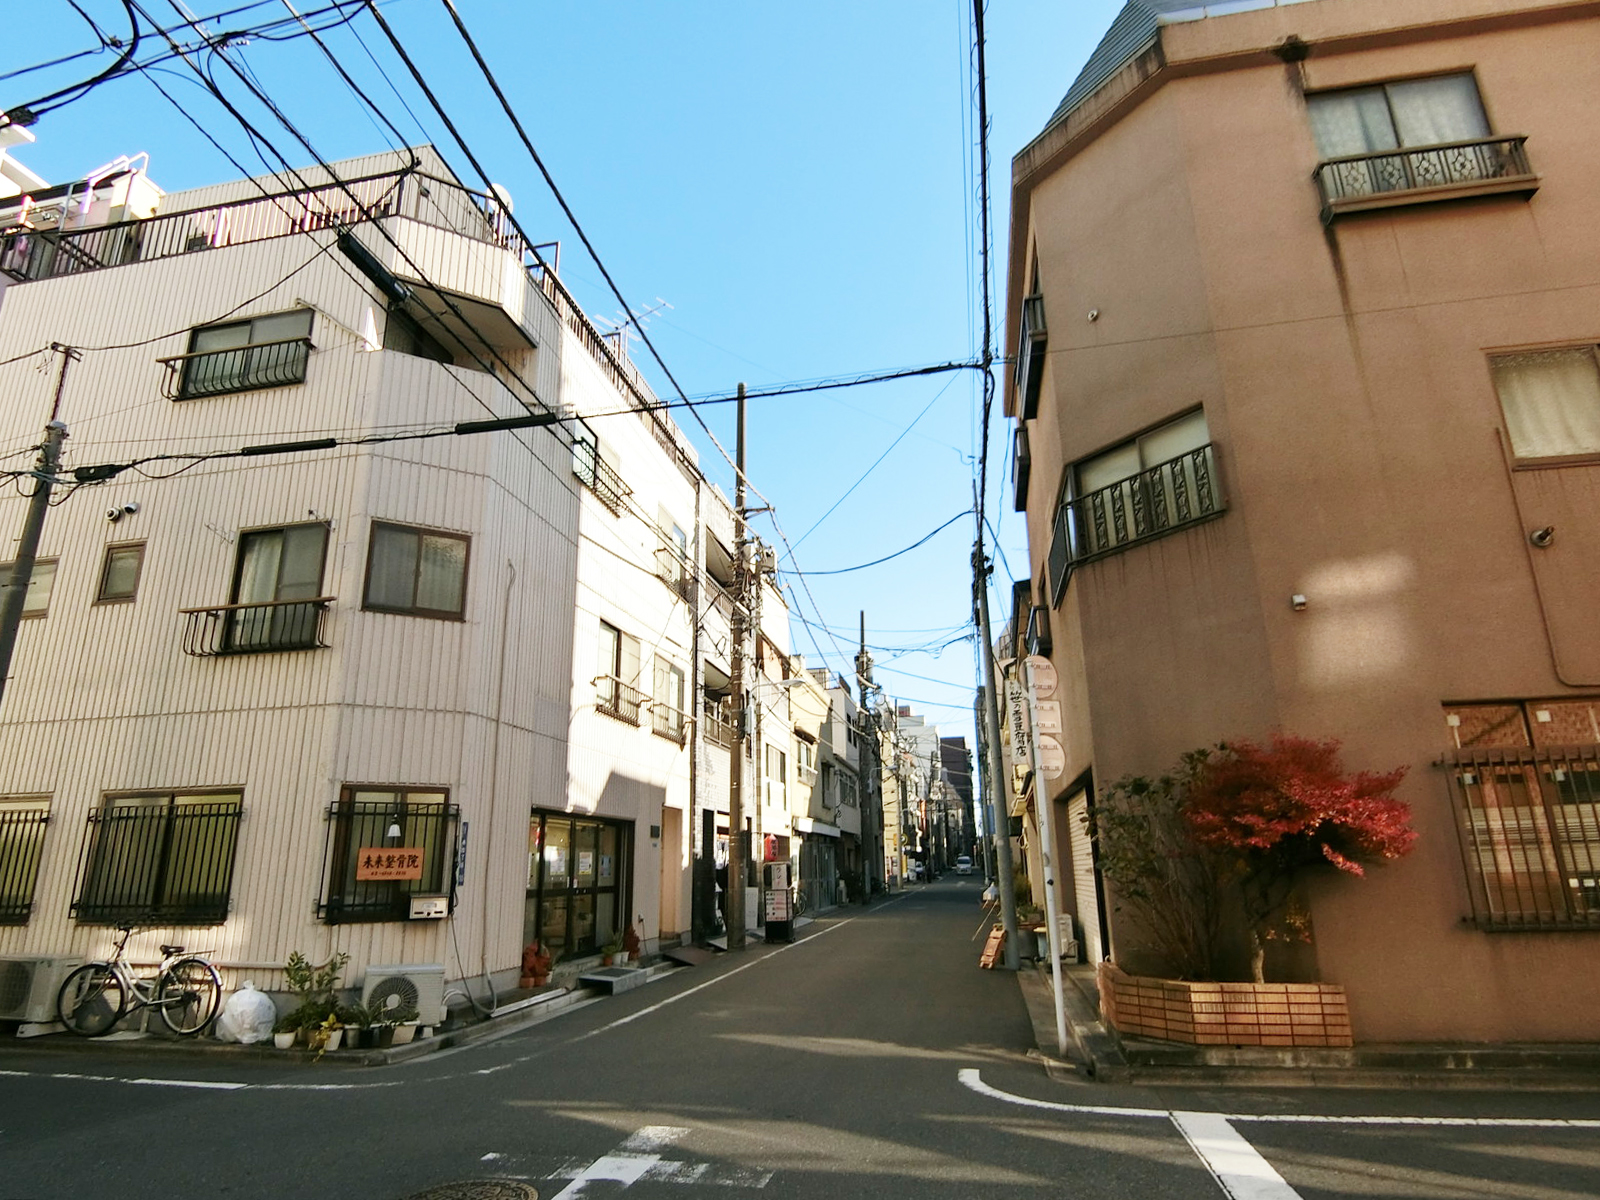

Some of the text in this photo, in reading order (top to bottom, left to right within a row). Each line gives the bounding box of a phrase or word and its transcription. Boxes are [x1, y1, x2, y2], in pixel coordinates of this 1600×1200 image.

[362, 854, 419, 869] 未来整骨院
